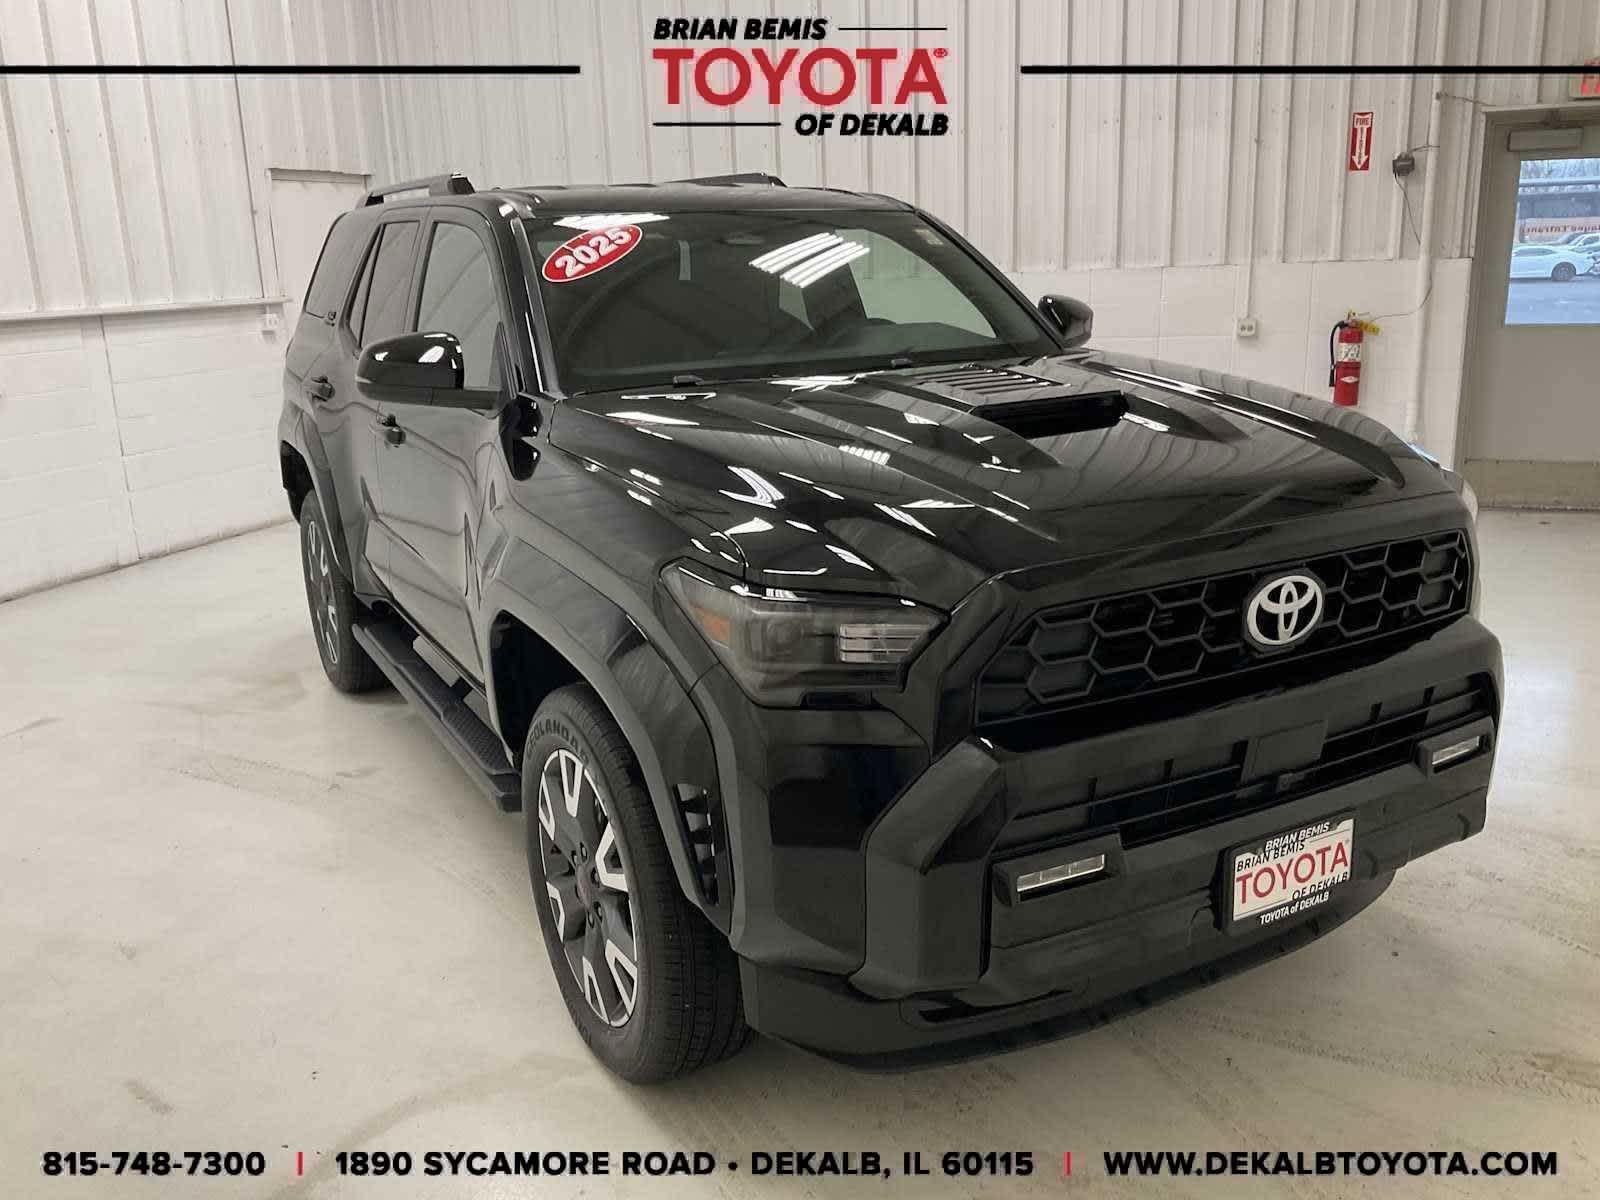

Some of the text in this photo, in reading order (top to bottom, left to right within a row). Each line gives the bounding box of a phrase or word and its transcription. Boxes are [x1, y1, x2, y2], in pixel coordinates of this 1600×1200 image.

[554, 227, 632, 278] 2025
[1265, 821, 1331, 851] BRIAN BEMIS
[1235, 841, 1349, 905] TOYOTA
[1236, 841, 1306, 873] BRIAN BEMIS
[1309, 871, 1349, 895] DEKALB
[1259, 891, 1330, 925] TOYOTA of DEKALB
